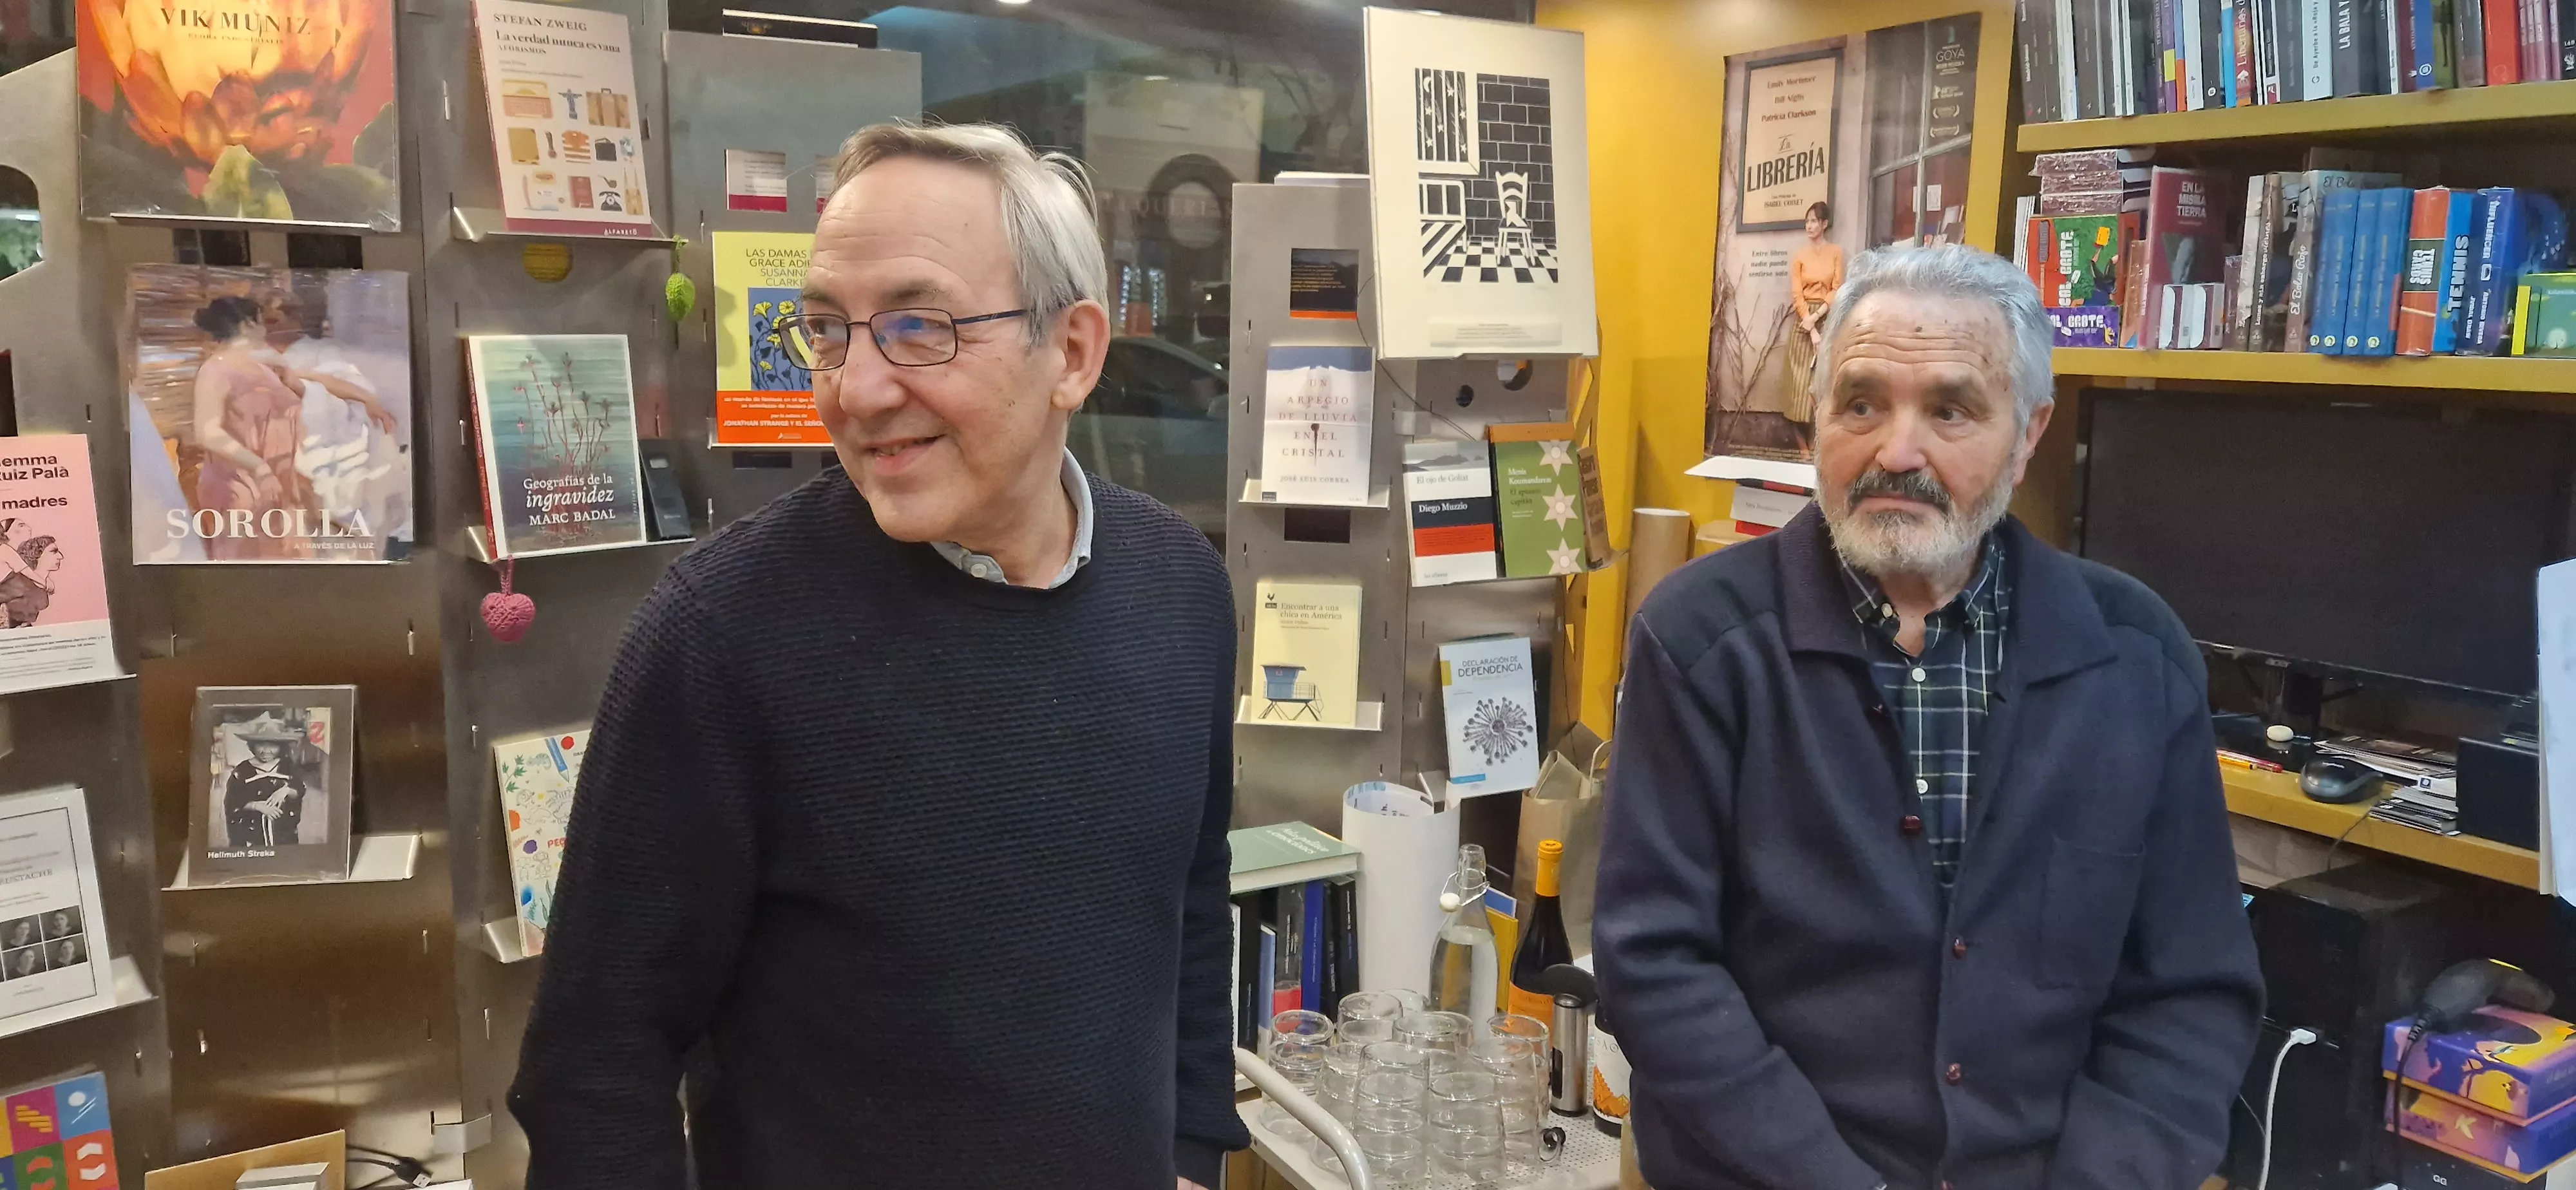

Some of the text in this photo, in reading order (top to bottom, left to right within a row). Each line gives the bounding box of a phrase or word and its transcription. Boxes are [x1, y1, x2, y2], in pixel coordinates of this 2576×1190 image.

[160, 8, 310, 34] VIK MUNIZ
[494, 14, 587, 32] STEFAN ZWEIG
[2339, 8, 2350, 35] BALA
[496, 30, 510, 41] La
[513, 33, 549, 45] verdad
[553, 39, 584, 48] nunca
[599, 44, 620, 53] vana
[2339, 35, 2350, 49] LA
[1936, 48, 1965, 62] GOYA
[1761, 109, 1816, 123] Patricia Clarkson
[1747, 142, 1824, 193] LIBRERÍA
[2182, 181, 2193, 193] EN
[2179, 194, 2206, 205] MISMA
[2177, 205, 2206, 218] TIERRA
[2483, 200, 2500, 259] INFLUENCER
[746, 249, 807, 258] LAS DAMAS
[749, 258, 787, 267] GRACE
[2260, 253, 2268, 283] embargo
[2409, 249, 2421, 285] CARDS
[2421, 248, 2436, 285] TENNIS
[2290, 244, 2309, 315] El Bolso Rojo
[2447, 234, 2470, 312] TENNIS
[1304, 413, 1358, 422] LLUVIA
[1294, 431, 1311, 440] EN
[1282, 448, 1345, 458] CRISTAL
[32, 465, 70, 480] Palà
[523, 473, 613, 491] Geografías de la
[1416, 476, 1424, 484] El
[1426, 477, 1436, 486] ojo
[1448, 475, 1468, 483] Goliat
[2, 496, 68, 509] madres
[526, 486, 614, 512] ingravidez
[1419, 502, 1468, 514] Diego Muzzio
[166, 508, 374, 539] SOROLLA
[529, 509, 616, 526] MARC BADAL
[302, 541, 332, 549] TRAVÉS
[1281, 603, 1317, 611] Encontrar
[1463, 656, 1508, 667] DECLARACIÓN
[1458, 663, 1523, 677] DEPENDENCIA
[207, 849, 276, 859] Hellmuth Straka
[0, 869, 53, 886] USTACHE
